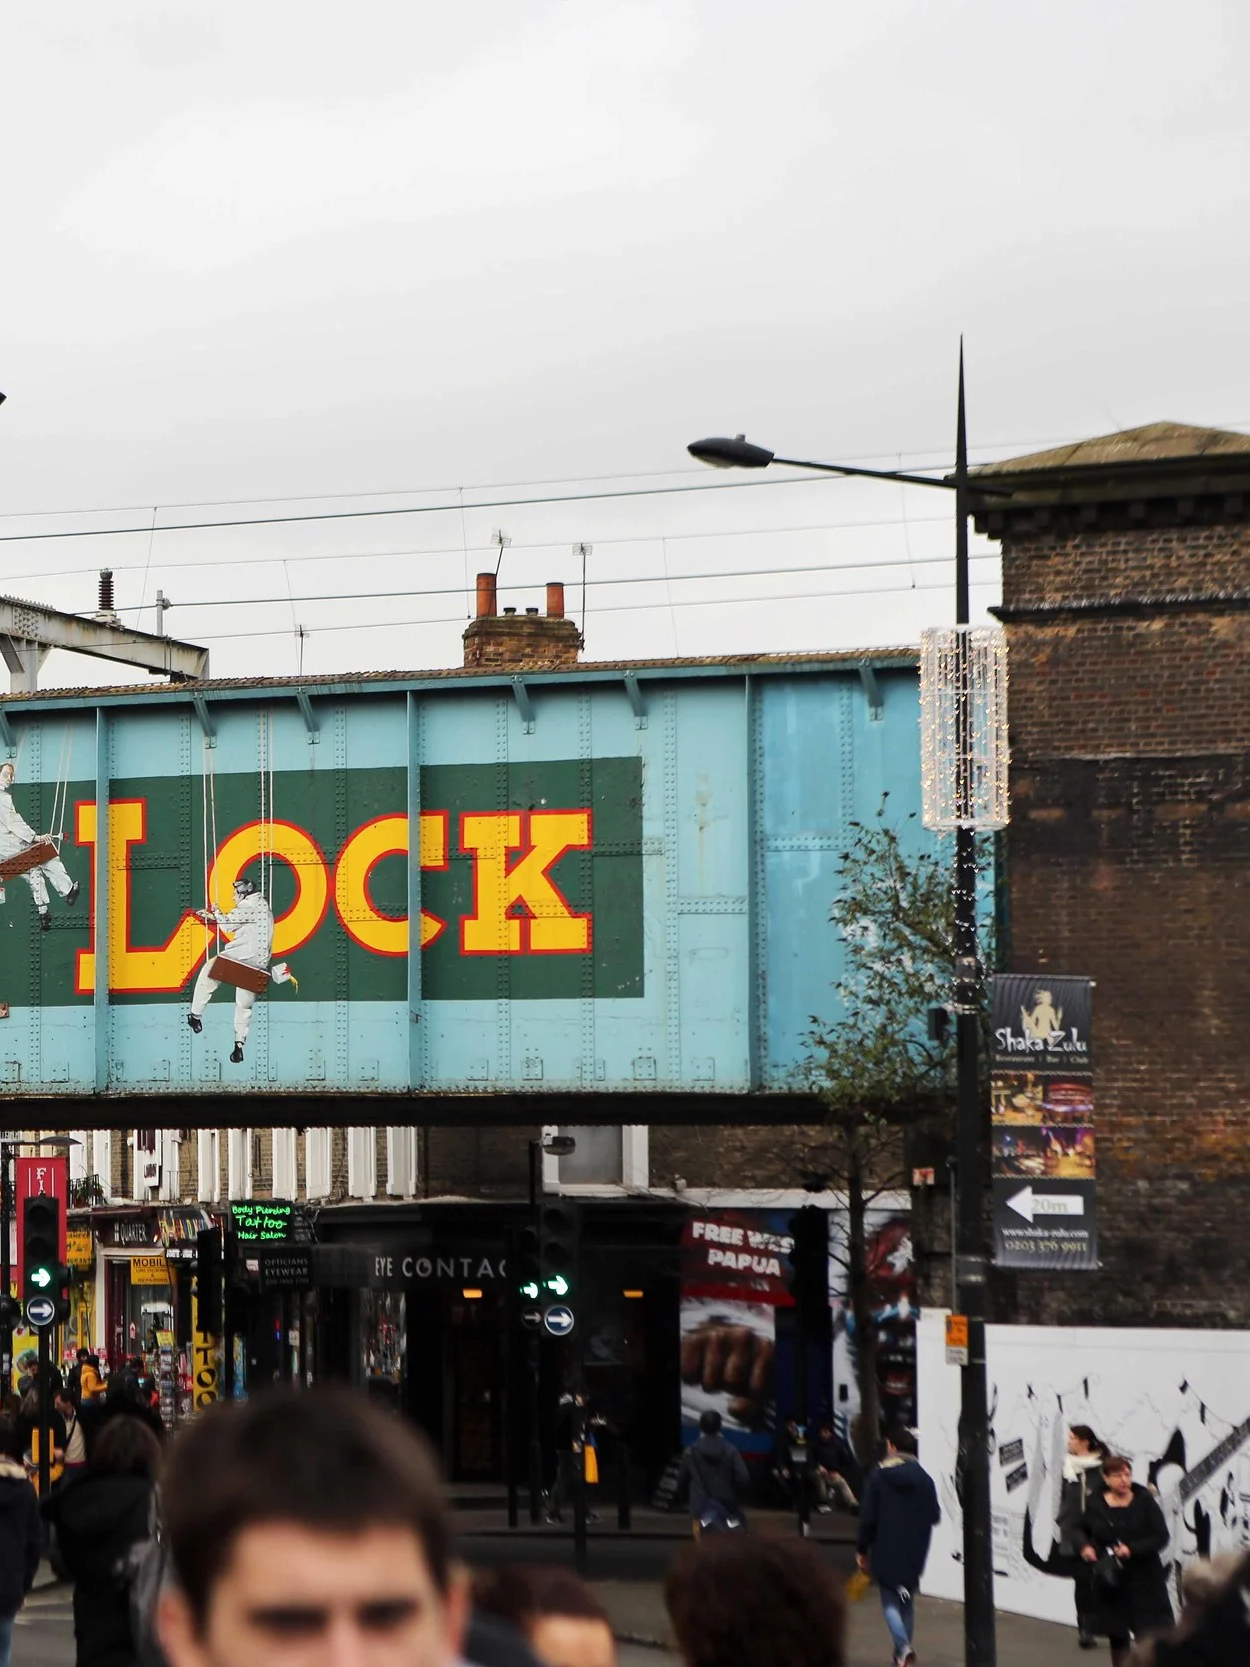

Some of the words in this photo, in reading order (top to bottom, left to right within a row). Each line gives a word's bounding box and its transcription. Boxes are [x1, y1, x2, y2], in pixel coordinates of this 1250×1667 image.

[73, 797, 594, 995] LOCK
[995, 1027, 1044, 1053] Shaka
[1047, 1027, 1087, 1052] Zulu
[232, 1204, 253, 1216] Body
[255, 1204, 291, 1216] Piercing
[1033, 1199, 1068, 1213] 20m
[235, 1215, 288, 1229] Tattoo
[120, 1223, 147, 1245] QUARTER
[237, 1232, 259, 1240] Hair
[260, 1230, 287, 1240] Salon
[692, 1221, 744, 1247] FREE
[264, 1258, 309, 1266] OPTICIANS
[375, 1256, 393, 1277] EYE
[707, 1248, 781, 1277] PAPUA
[265, 1267, 308, 1277] EYEWEAR
